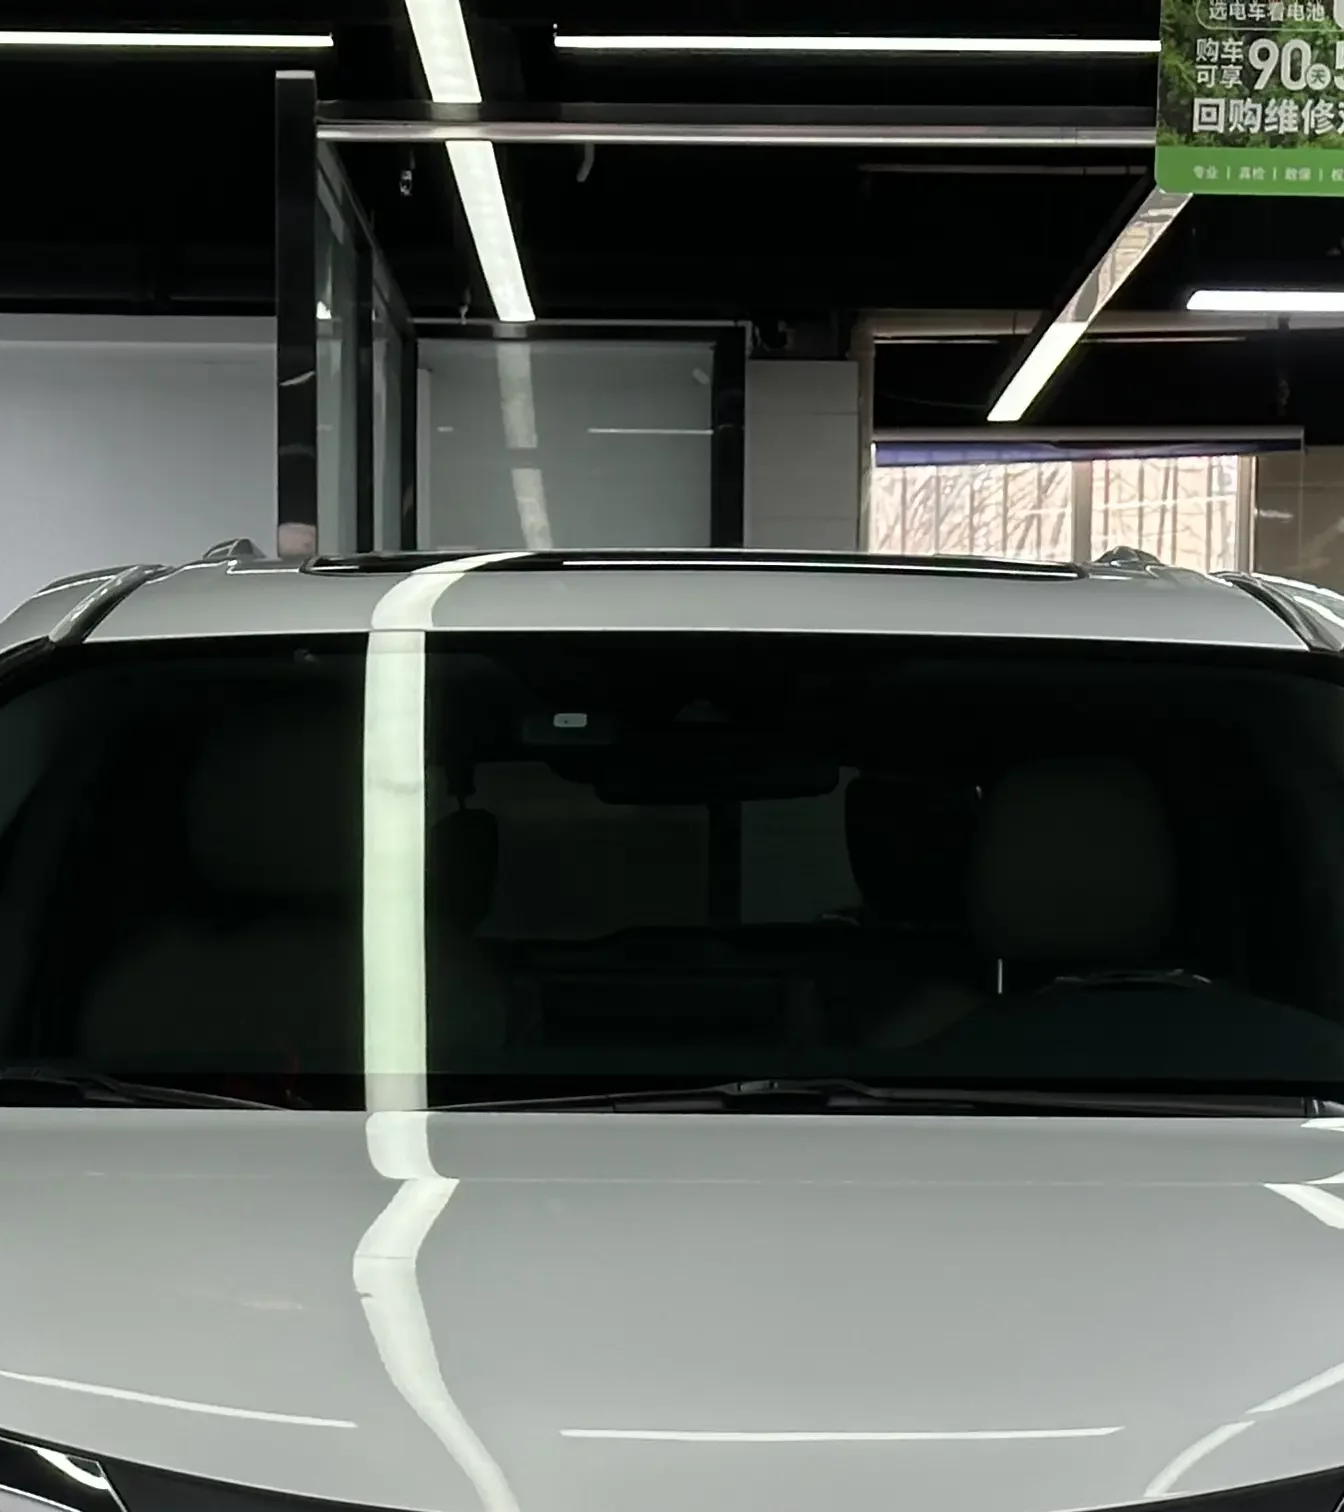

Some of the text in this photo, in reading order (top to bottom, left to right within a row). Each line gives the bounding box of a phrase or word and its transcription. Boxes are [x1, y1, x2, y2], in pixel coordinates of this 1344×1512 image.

[1208, 0, 1325, 22] 选电车看电池
